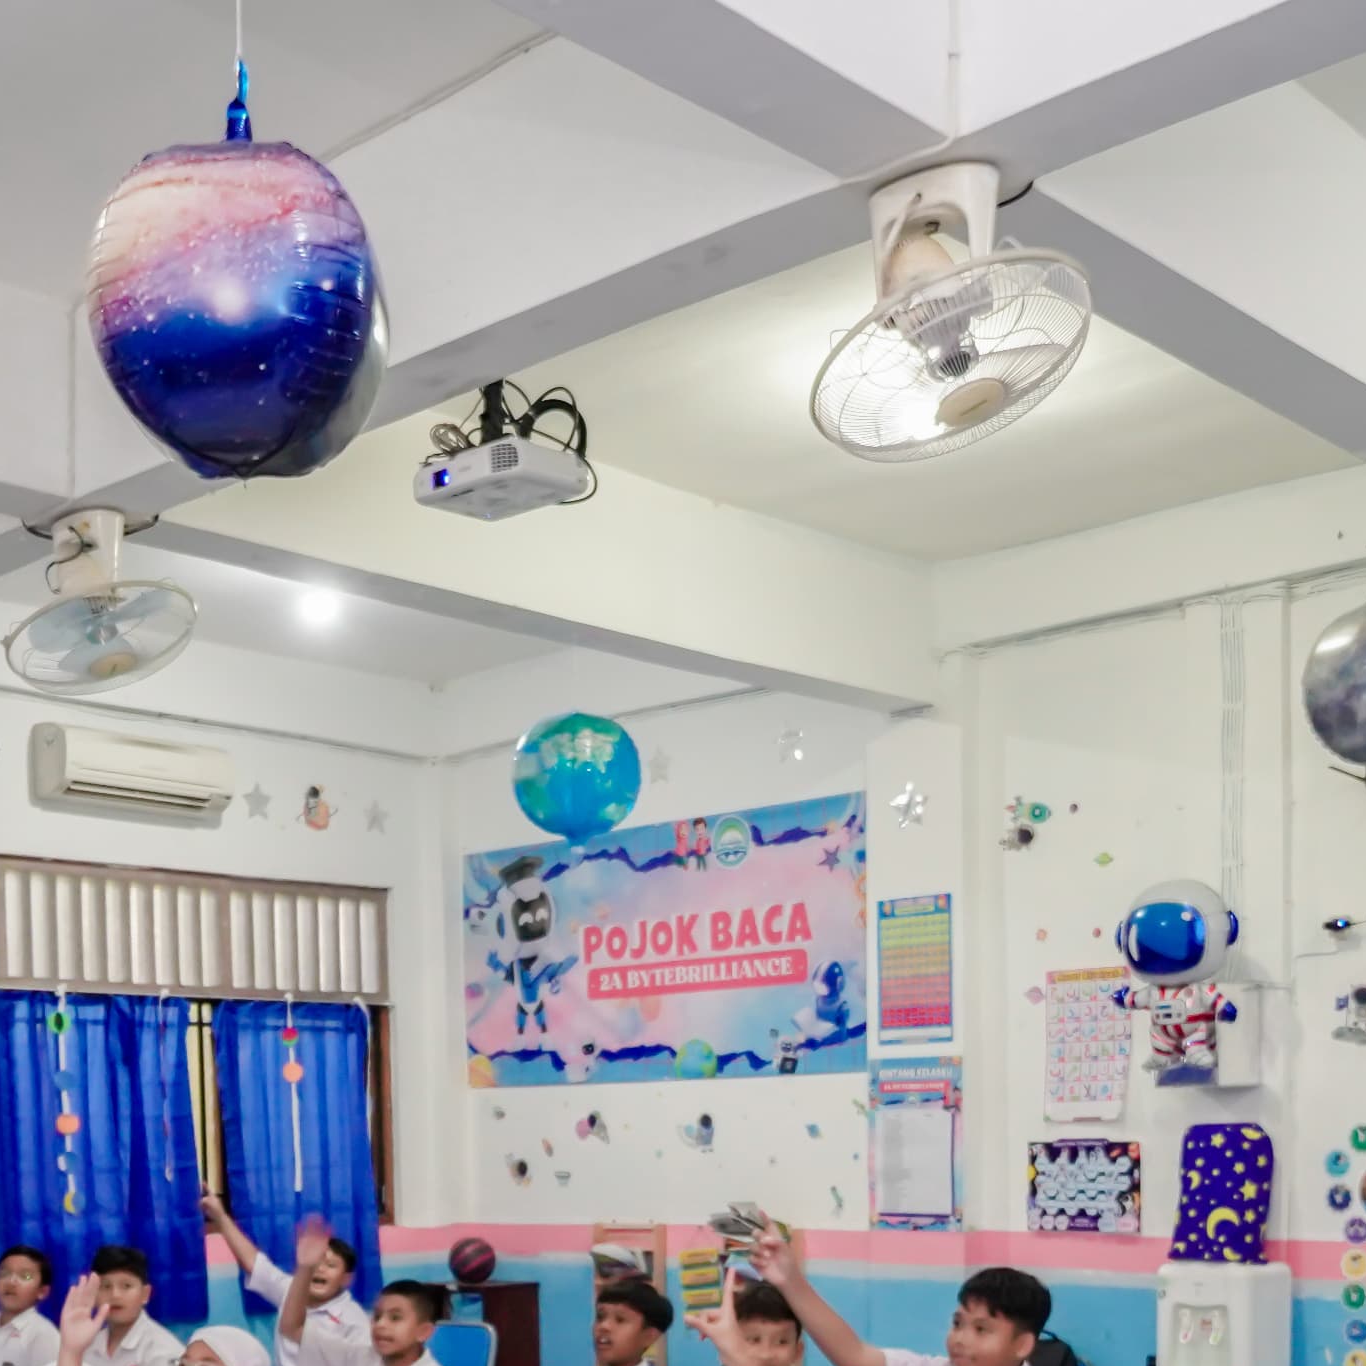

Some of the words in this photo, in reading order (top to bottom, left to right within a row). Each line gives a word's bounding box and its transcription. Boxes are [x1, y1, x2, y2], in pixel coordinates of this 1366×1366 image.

[583, 913, 701, 965] POJOK
[710, 902, 813, 948] BACA
[598, 971, 624, 992] 2A
[627, 956, 793, 988] BYTEBRILLIANCE
